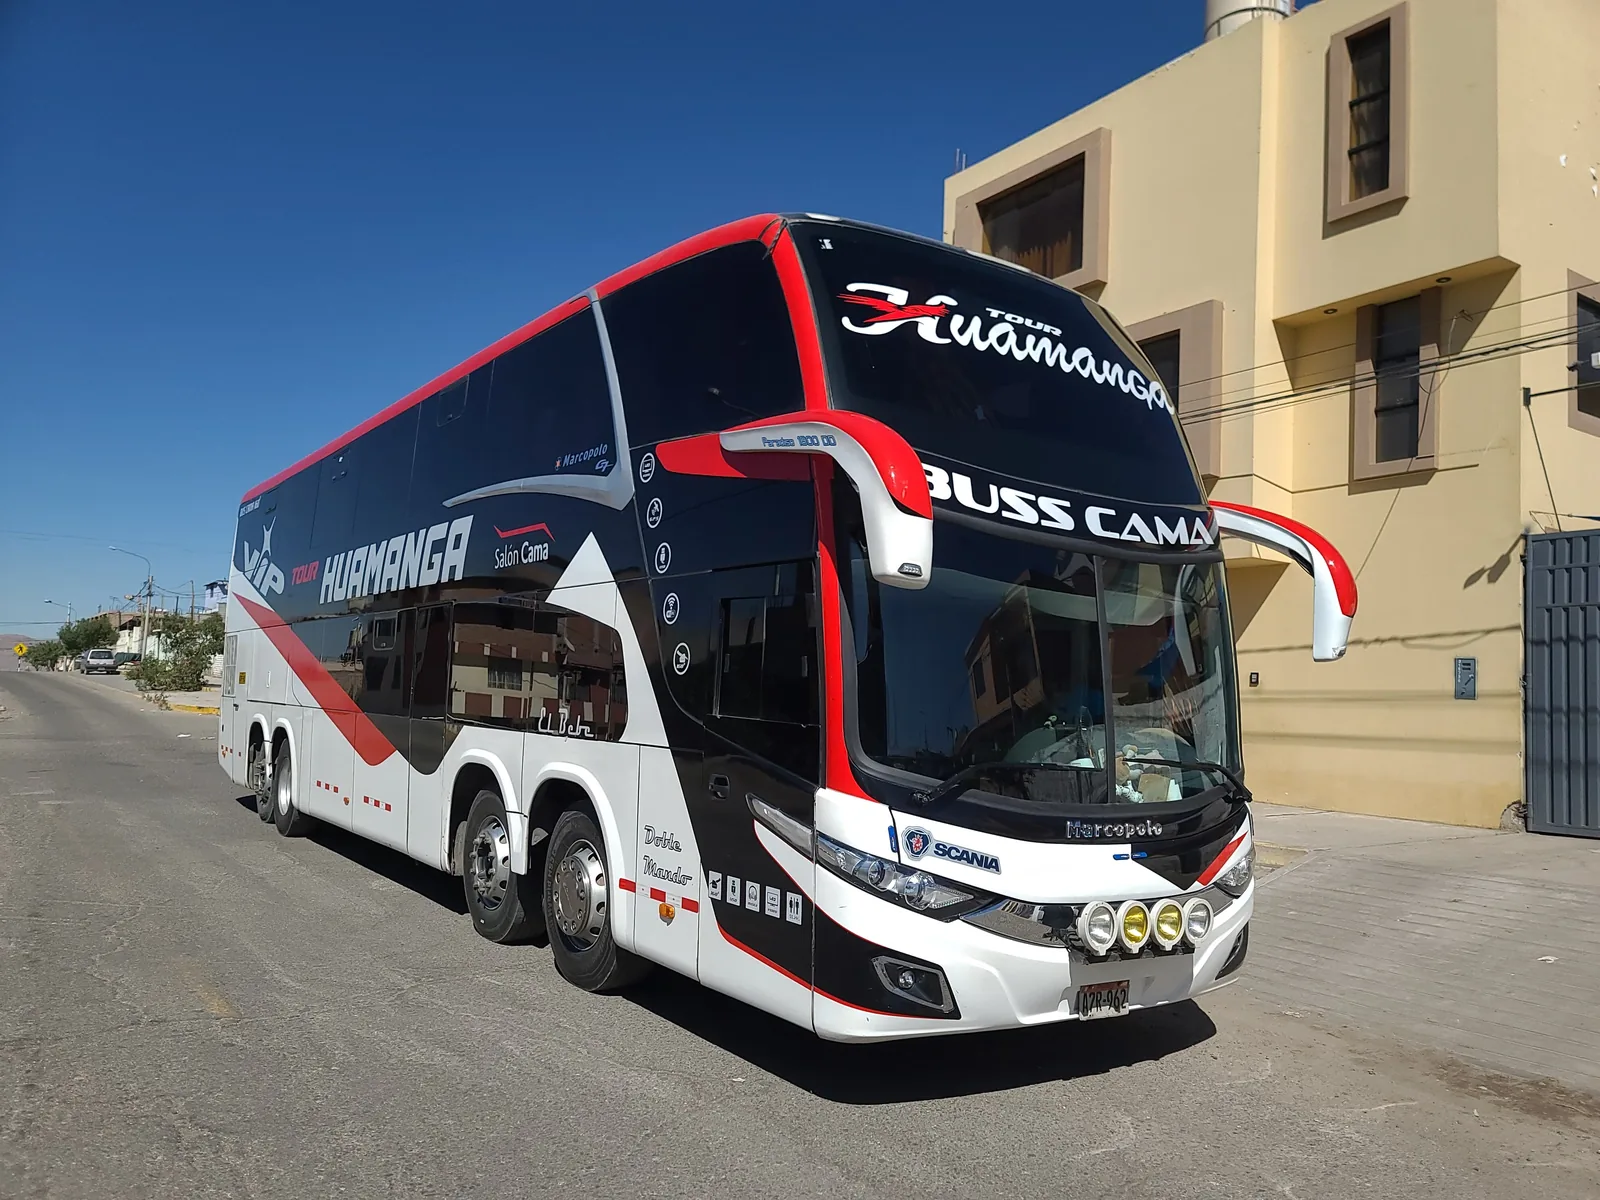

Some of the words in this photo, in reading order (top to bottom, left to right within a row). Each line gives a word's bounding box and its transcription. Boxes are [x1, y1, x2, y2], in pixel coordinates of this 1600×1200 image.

[985, 307, 1063, 337] TOUR
[562, 443, 608, 468] Marcopolo
[920, 463, 1075, 531] BUSS
[1085, 505, 1215, 546] CAMA
[292, 561, 320, 586] TOUR
[319, 514, 474, 605] HUAMANGA
[494, 543, 519, 569] Salón
[520, 541, 549, 564] Cama
[644, 824, 682, 852] Doble
[1066, 820, 1163, 839] Marcopolo
[643, 854, 693, 886] Mando
[933, 842, 1001, 872] SCANIA
